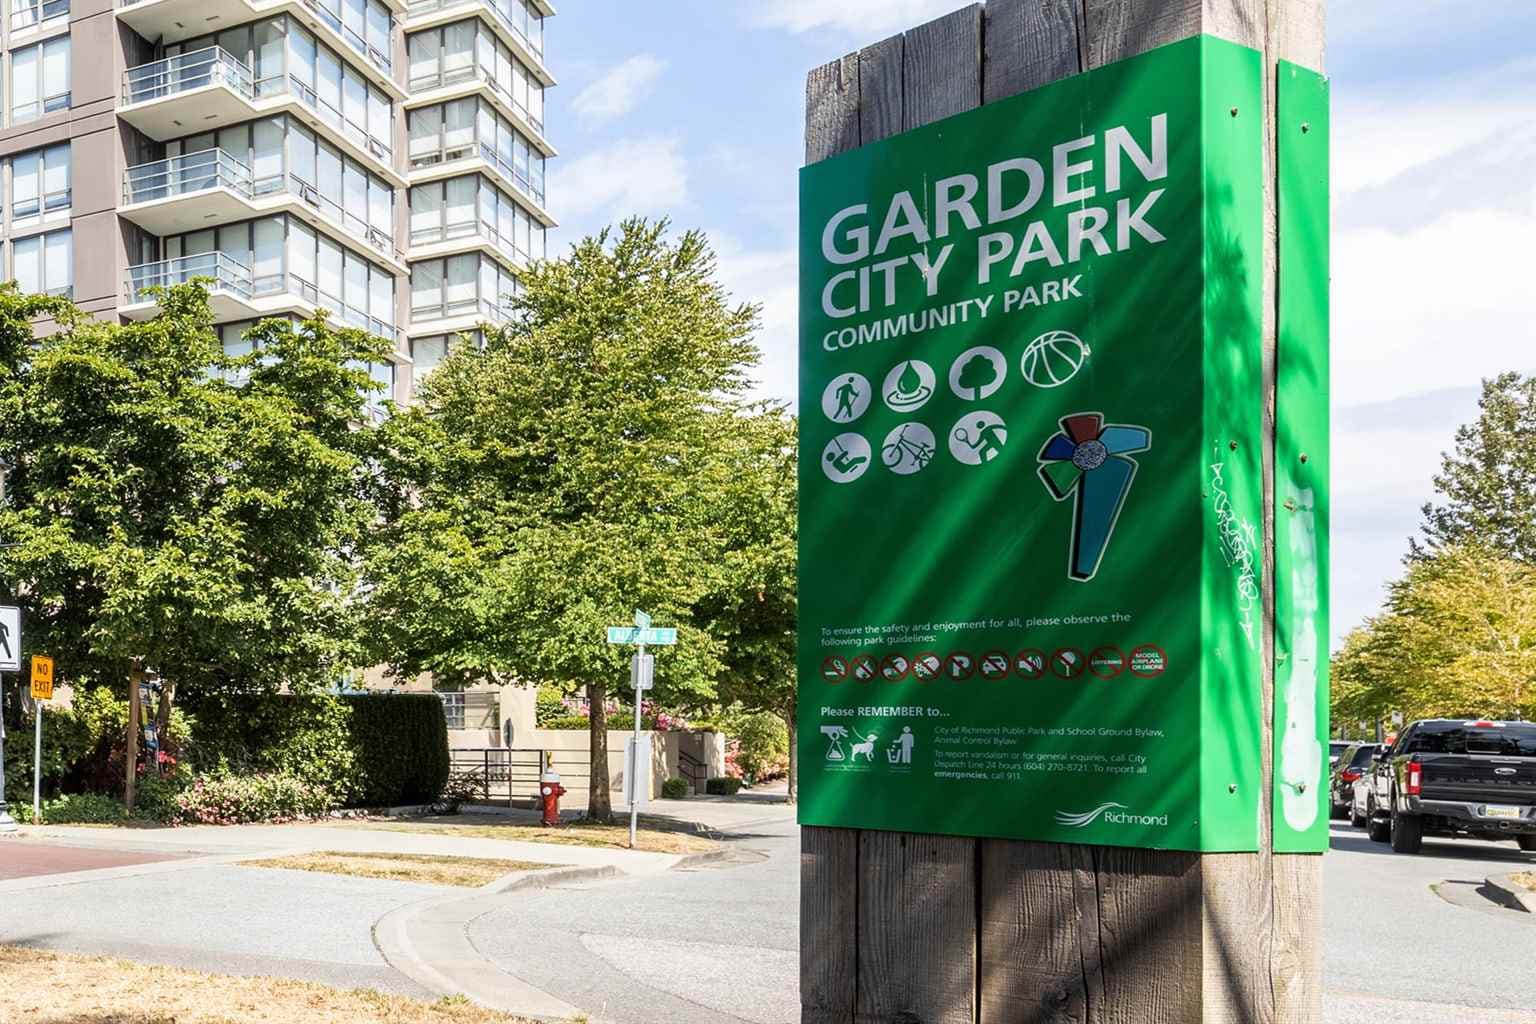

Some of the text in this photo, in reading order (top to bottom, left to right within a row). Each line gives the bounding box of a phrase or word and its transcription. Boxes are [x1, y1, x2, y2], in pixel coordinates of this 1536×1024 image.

[821, 112, 1168, 265] GARDEN
[821, 188, 1167, 319] CITY PARK
[822, 273, 1083, 352] COMMUNITY PARK
[833, 627, 862, 636] ensure
[865, 625, 880, 634] the
[881, 624, 910, 634] safety
[912, 622, 931, 632] and
[933, 621, 986, 632] enjoyment
[989, 618, 1004, 628] for
[1007, 618, 1022, 628] all,
[1026, 616, 1060, 628] please
[1064, 614, 1108, 625] observe
[1111, 613, 1132, 623] the
[821, 634, 937, 648] following park guidelines:
[36, 663, 49, 675] NO
[34, 680, 50, 692] EXIT
[821, 706, 855, 716] Please
[857, 706, 924, 717] REMEMBER
[1027, 727, 1045, 736] Park
[1047, 727, 1064, 736] and
[1066, 727, 1096, 736] School
[1098, 727, 1133, 737] Ground
[1135, 728, 1165, 739] Bylaw,
[1022, 752, 1034, 760] for
[1037, 753, 1068, 762] general
[1110, 754, 1126, 762] call
[1128, 754, 1146, 765] City
[1105, 764, 1134, 775] report
[1136, 765, 1148, 774] all
[1104, 811, 1168, 826] Richmond
